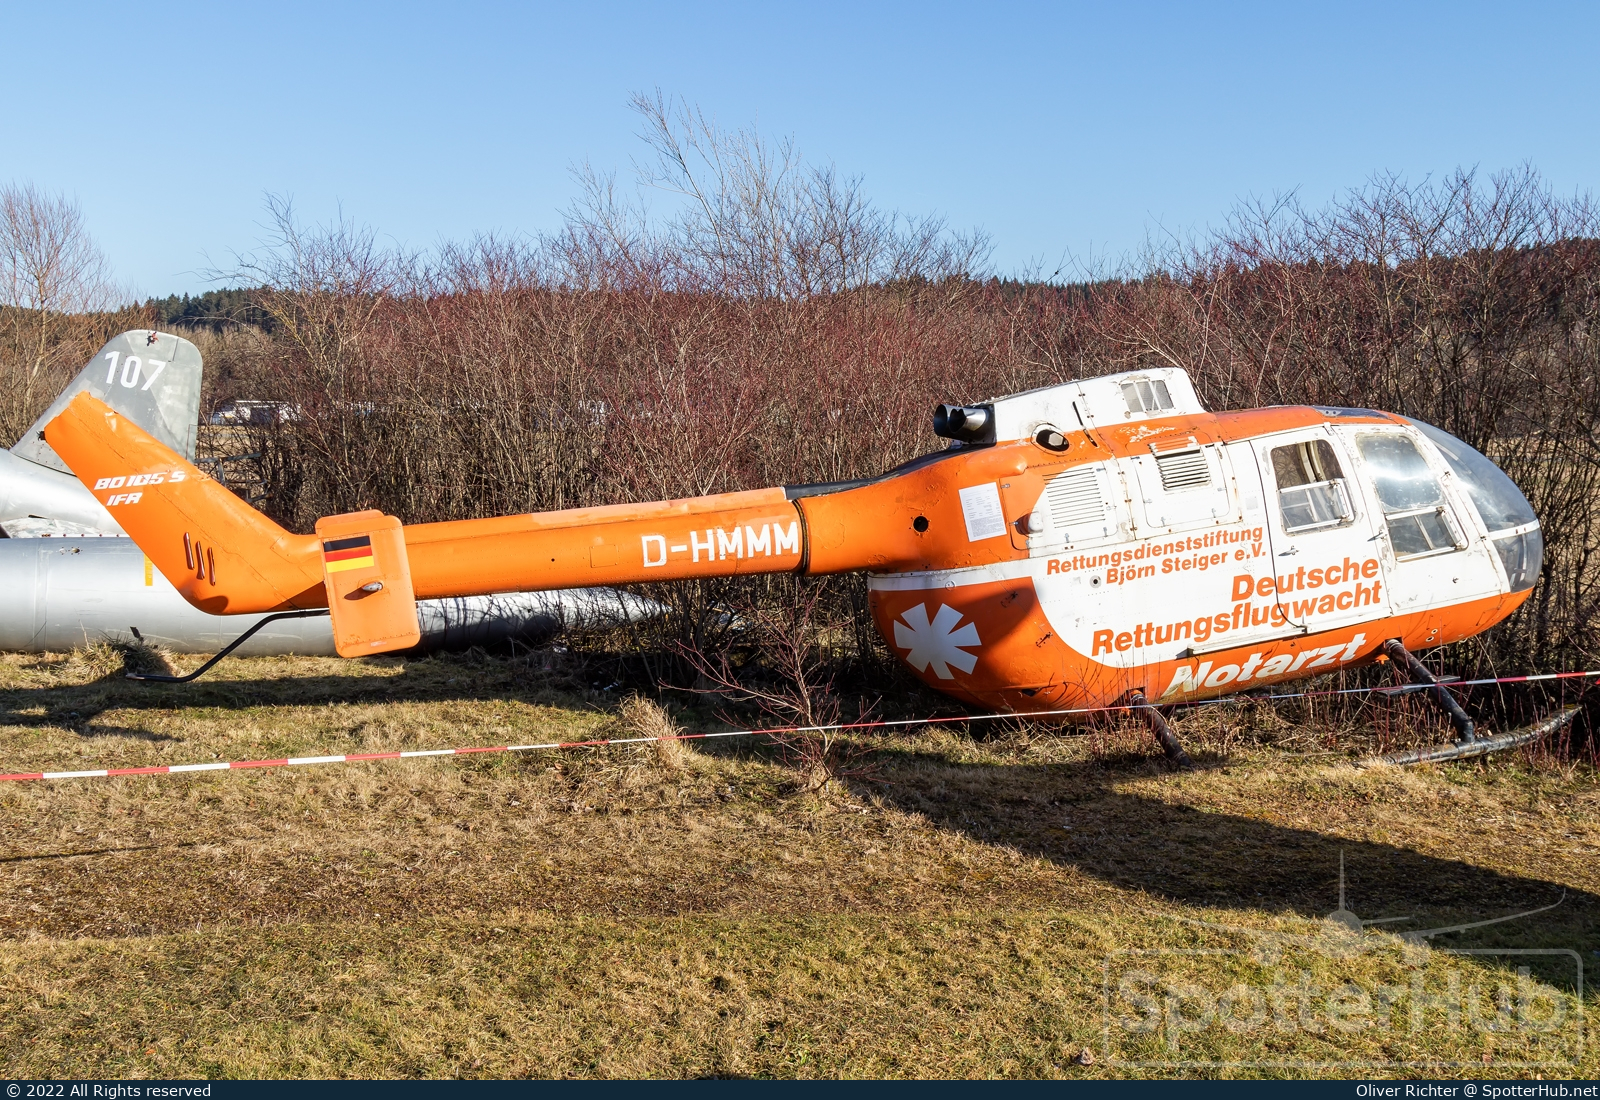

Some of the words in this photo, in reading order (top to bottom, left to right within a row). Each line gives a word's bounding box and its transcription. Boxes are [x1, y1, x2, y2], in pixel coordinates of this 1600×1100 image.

[104, 351, 166, 391] 107
[106, 492, 143, 506] IFR
[168, 471, 185, 483] S
[641, 521, 799, 568] D-HMMM
[1046, 527, 1264, 576] Rettungsdienststiftung
[1106, 563, 1156, 585] Björn
[1161, 550, 1229, 574] Steiger
[1234, 542, 1267, 561] e.V.
[1231, 556, 1379, 602] Deutsche
[1091, 580, 1383, 657] Rettungsflugwacht
[1161, 633, 1367, 698] Notarzt
